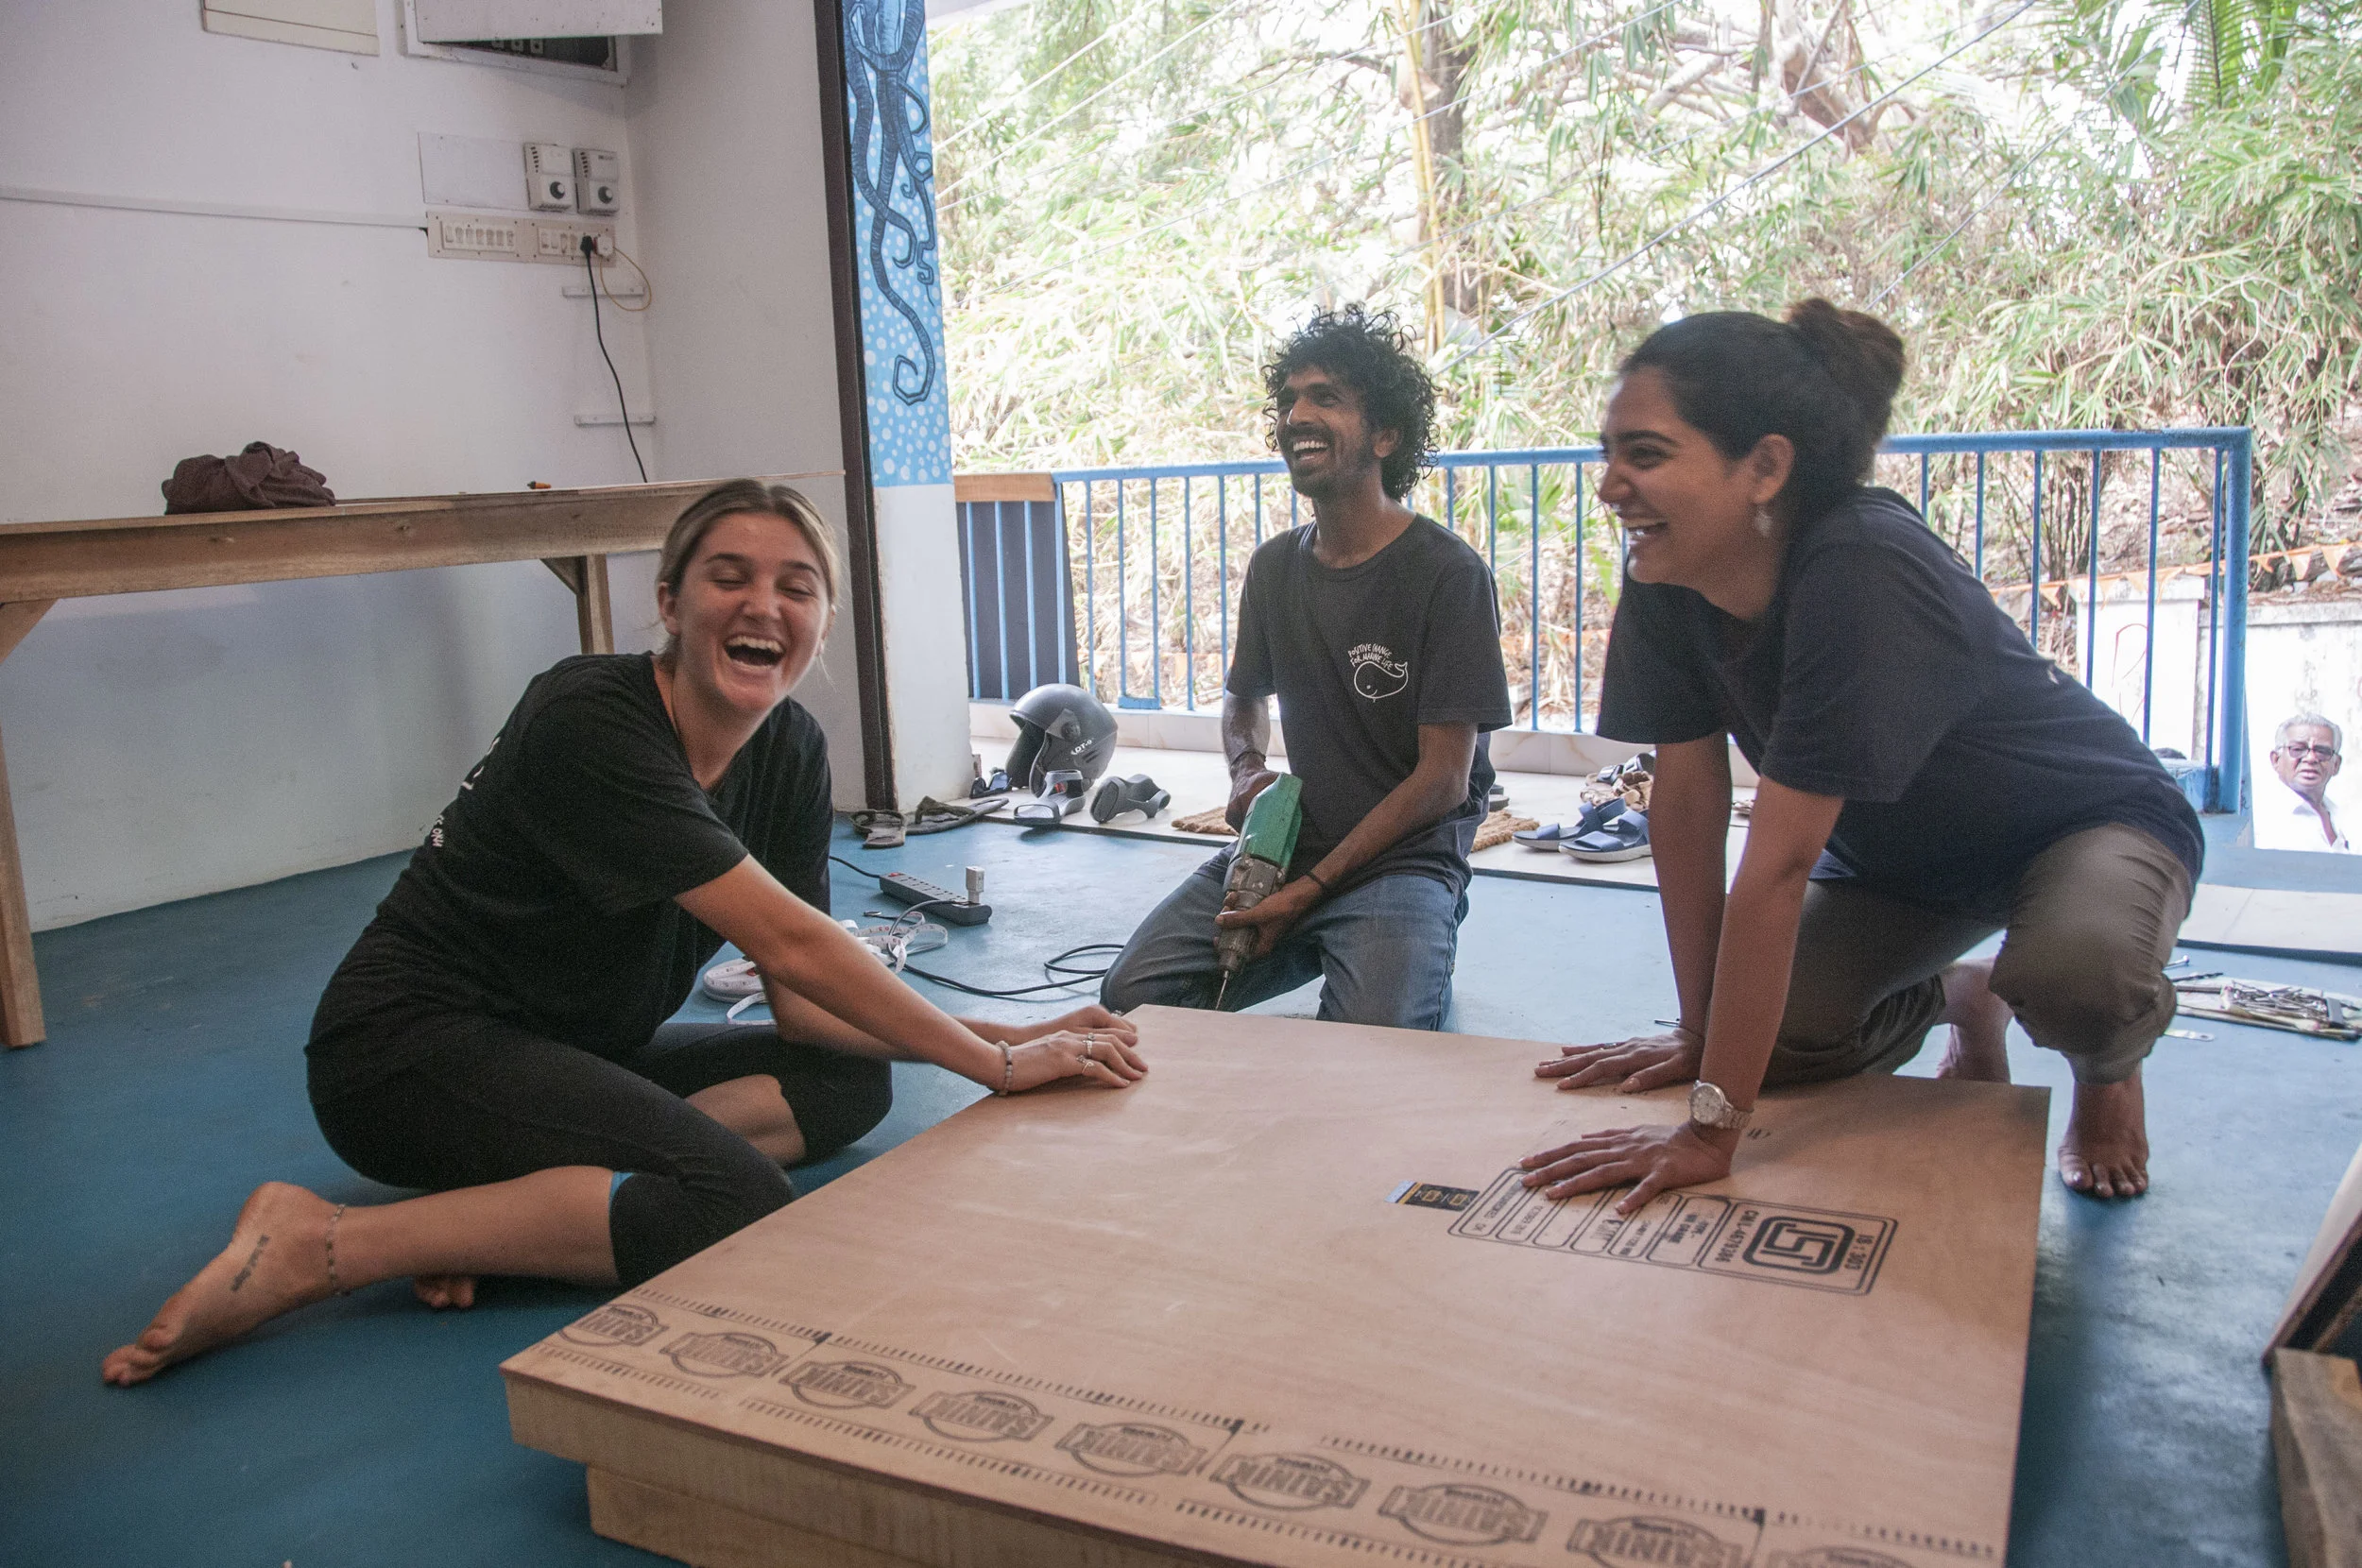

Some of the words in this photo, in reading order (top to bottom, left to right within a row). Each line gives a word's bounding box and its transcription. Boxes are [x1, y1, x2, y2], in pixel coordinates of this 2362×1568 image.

[1347, 643, 1372, 657] POSITIVE
[1372, 643, 1393, 658] CHANGE
[1350, 655, 1362, 667] FOR
[1362, 653, 1383, 663] MARINE
[1381, 658, 1394, 671] LIFE
[920, 1397, 1037, 1437] SAINIK
[1230, 1460, 1352, 1503] SAINIK
[1405, 1491, 1532, 1539] SAINIK
